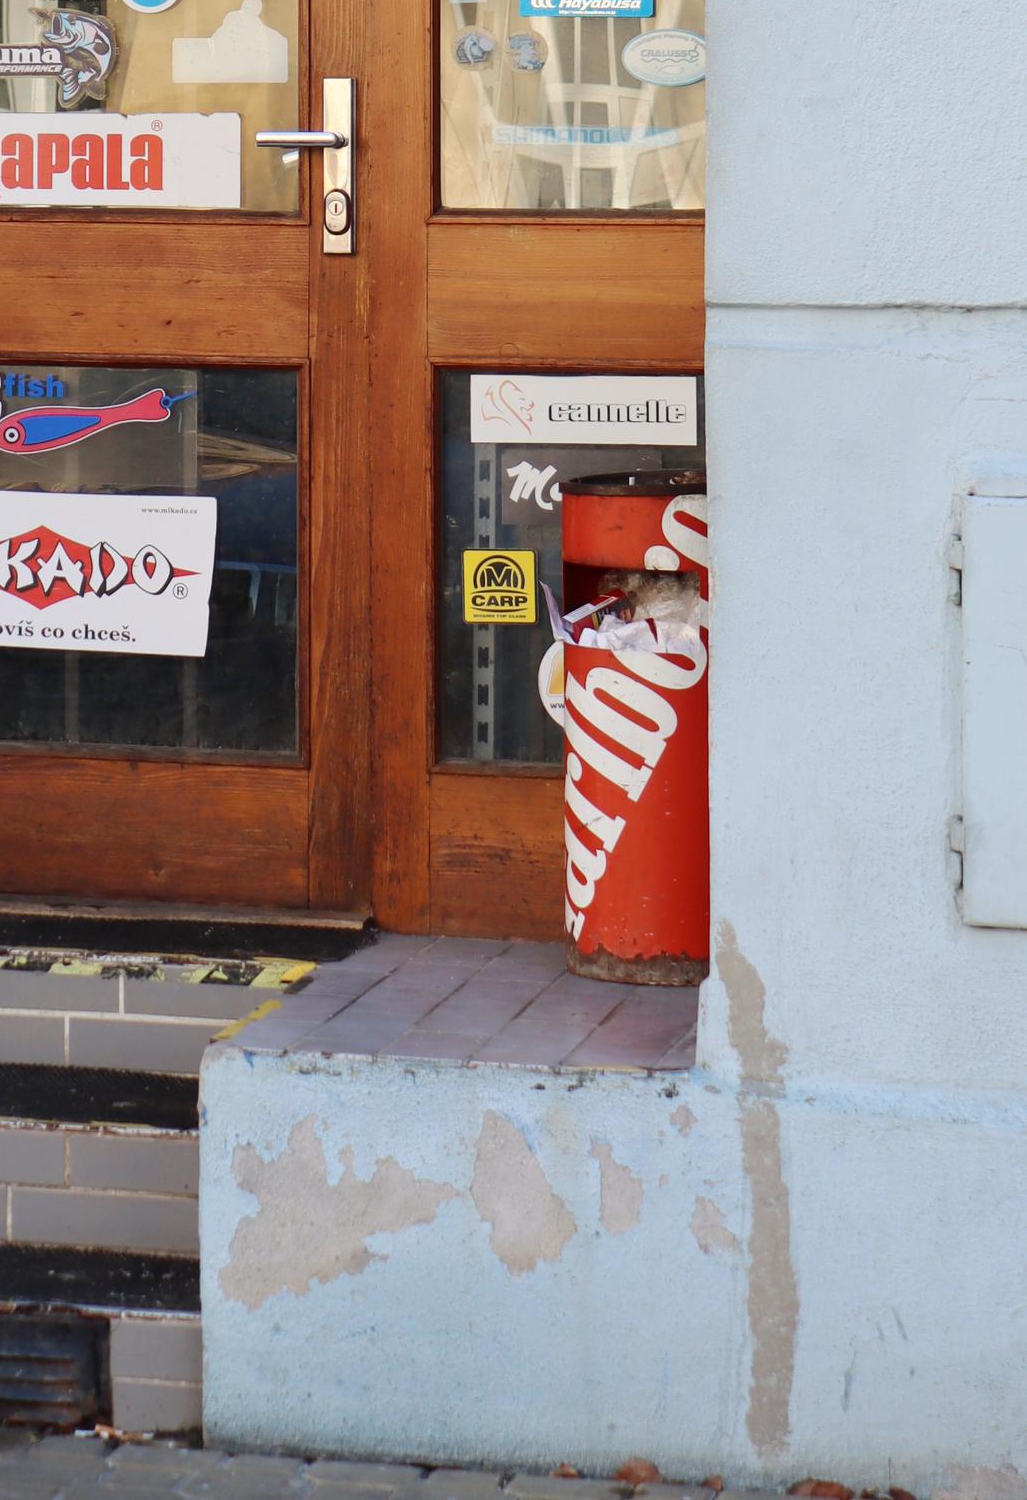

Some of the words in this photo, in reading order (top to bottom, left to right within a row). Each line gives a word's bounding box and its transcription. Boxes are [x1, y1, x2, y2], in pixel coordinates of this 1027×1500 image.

[3, 373, 65, 398] fish
[548, 399, 687, 424] cannelle
[471, 595, 528, 607] CARP
[41, 625, 64, 639] co
[71, 624, 136, 643] chceš.
